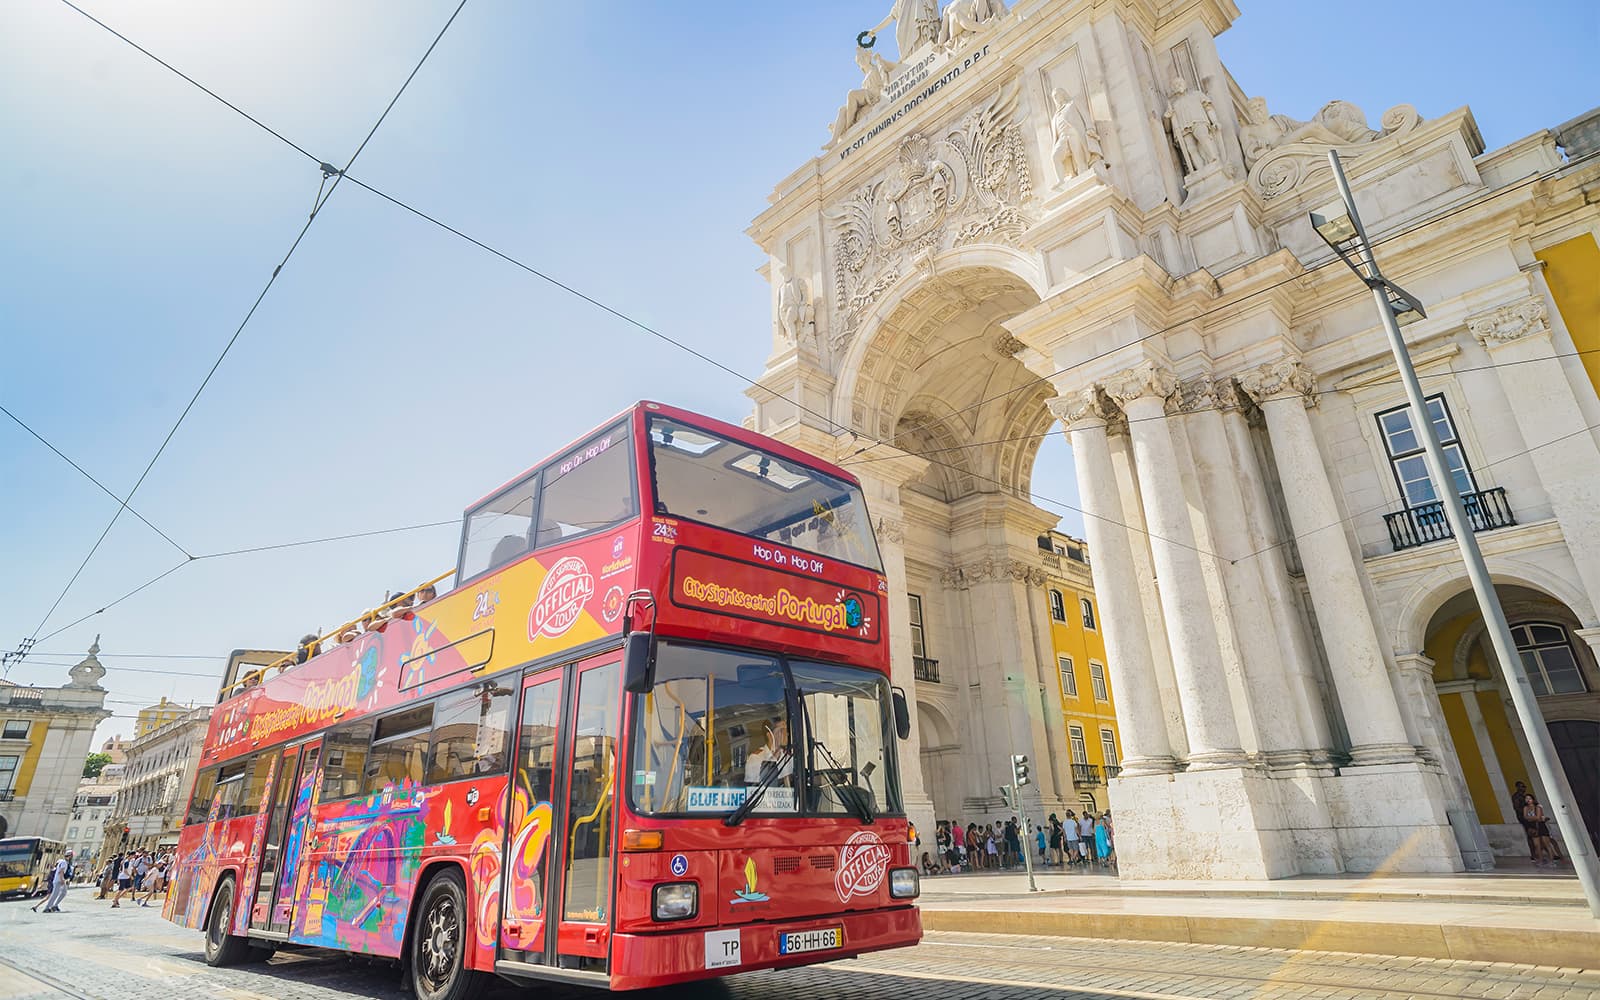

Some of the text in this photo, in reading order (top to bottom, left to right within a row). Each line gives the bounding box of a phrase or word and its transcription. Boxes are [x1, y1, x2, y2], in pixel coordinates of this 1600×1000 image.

[840, 146, 851, 160] VT
[853, 135, 865, 150] SIT
[560, 461, 574, 475] Hop
[585, 446, 599, 460] Hop
[753, 544, 824, 574] Hop On Hop Off
[535, 577, 592, 626] OFFICIAL
[555, 602, 579, 627] TOUR
[777, 588, 848, 631] Portugal
[690, 791, 719, 807] BLUE
[721, 791, 745, 807] LINE
[842, 846, 889, 888] OFFICIAL
[864, 865, 883, 886] TOUR
[722, 940, 739, 956] TP
